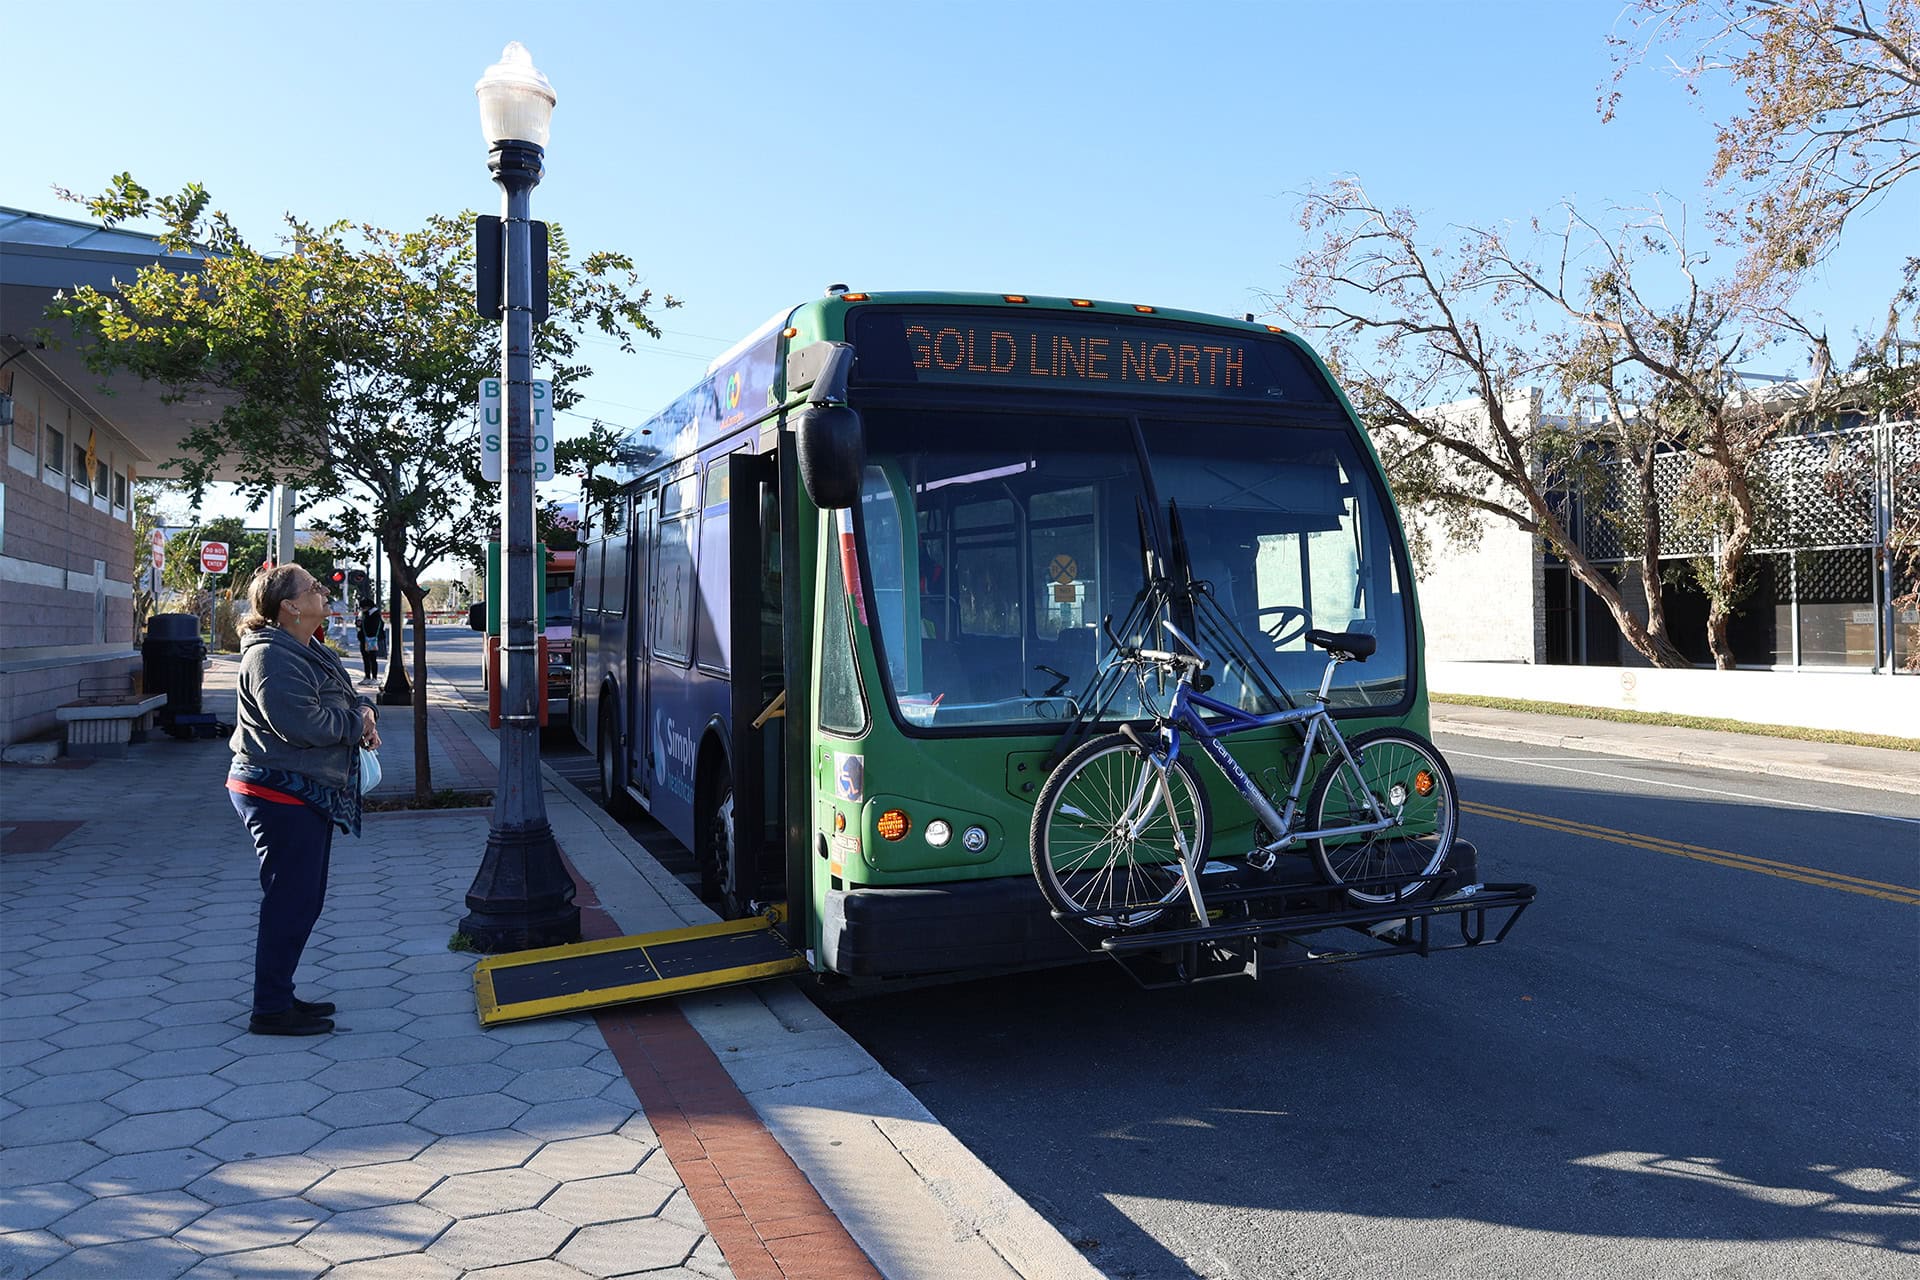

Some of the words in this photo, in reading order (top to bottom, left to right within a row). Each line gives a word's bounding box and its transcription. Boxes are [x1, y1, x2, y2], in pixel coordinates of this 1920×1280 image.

[906, 325, 1017, 374] GOLD
[1030, 334, 1109, 379] LINE
[1122, 340, 1244, 387] NORTH
[484, 381, 501, 452] BUS
[533, 382, 549, 479] STOP
[667, 717, 696, 781] Simply
[1212, 738, 1267, 807] cannondale
